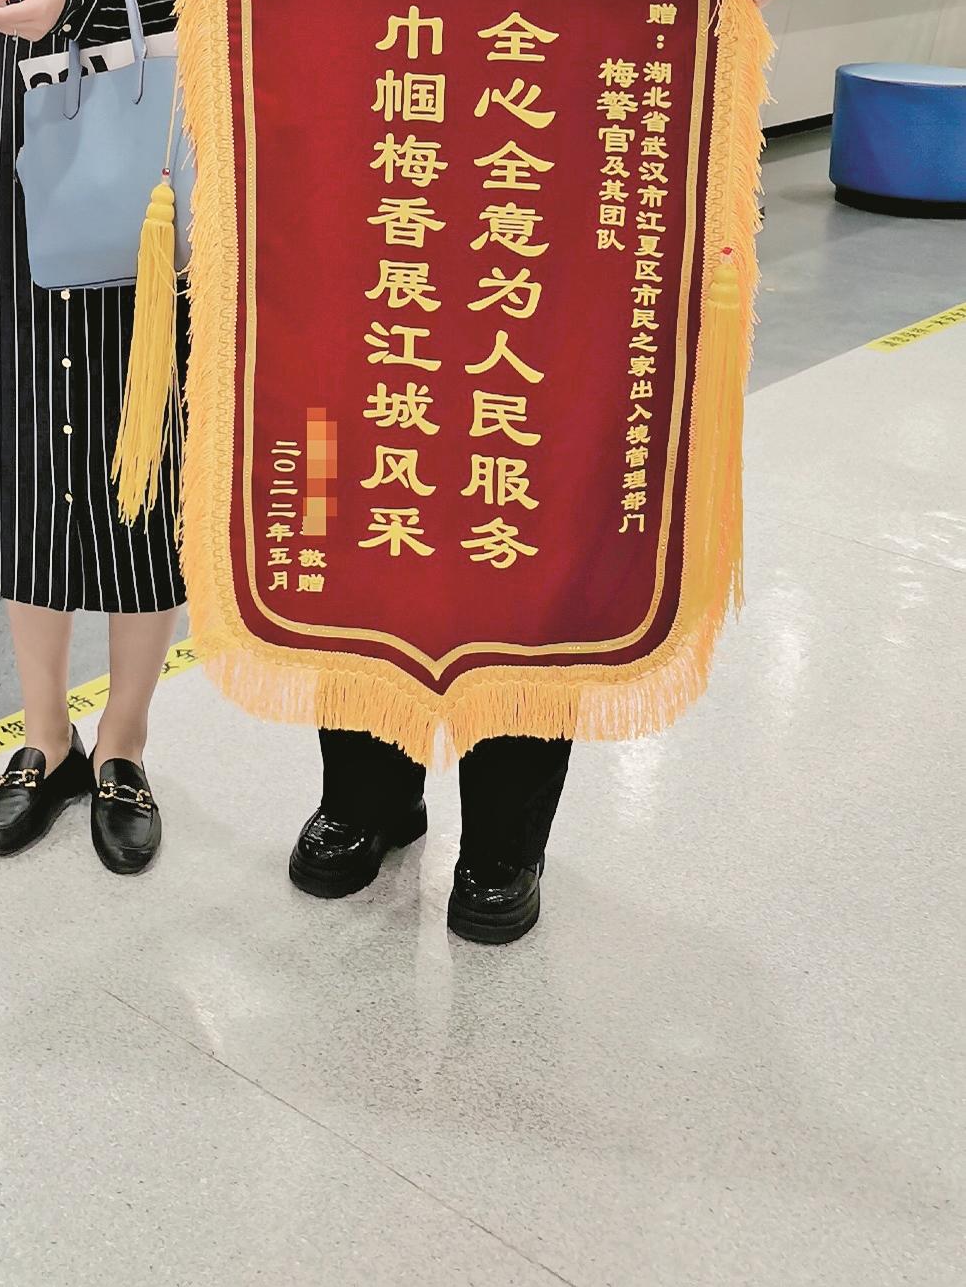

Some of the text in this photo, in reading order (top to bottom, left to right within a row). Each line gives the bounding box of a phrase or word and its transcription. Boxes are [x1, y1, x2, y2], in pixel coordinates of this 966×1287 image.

[358, 5, 448, 557] 巾帼梅香展江城风采
[460, 11, 559, 569] 全心全意为人民服务
[595, 57, 639, 252] 梅警官及其团队
[296, 548, 327, 592] 敬赠
